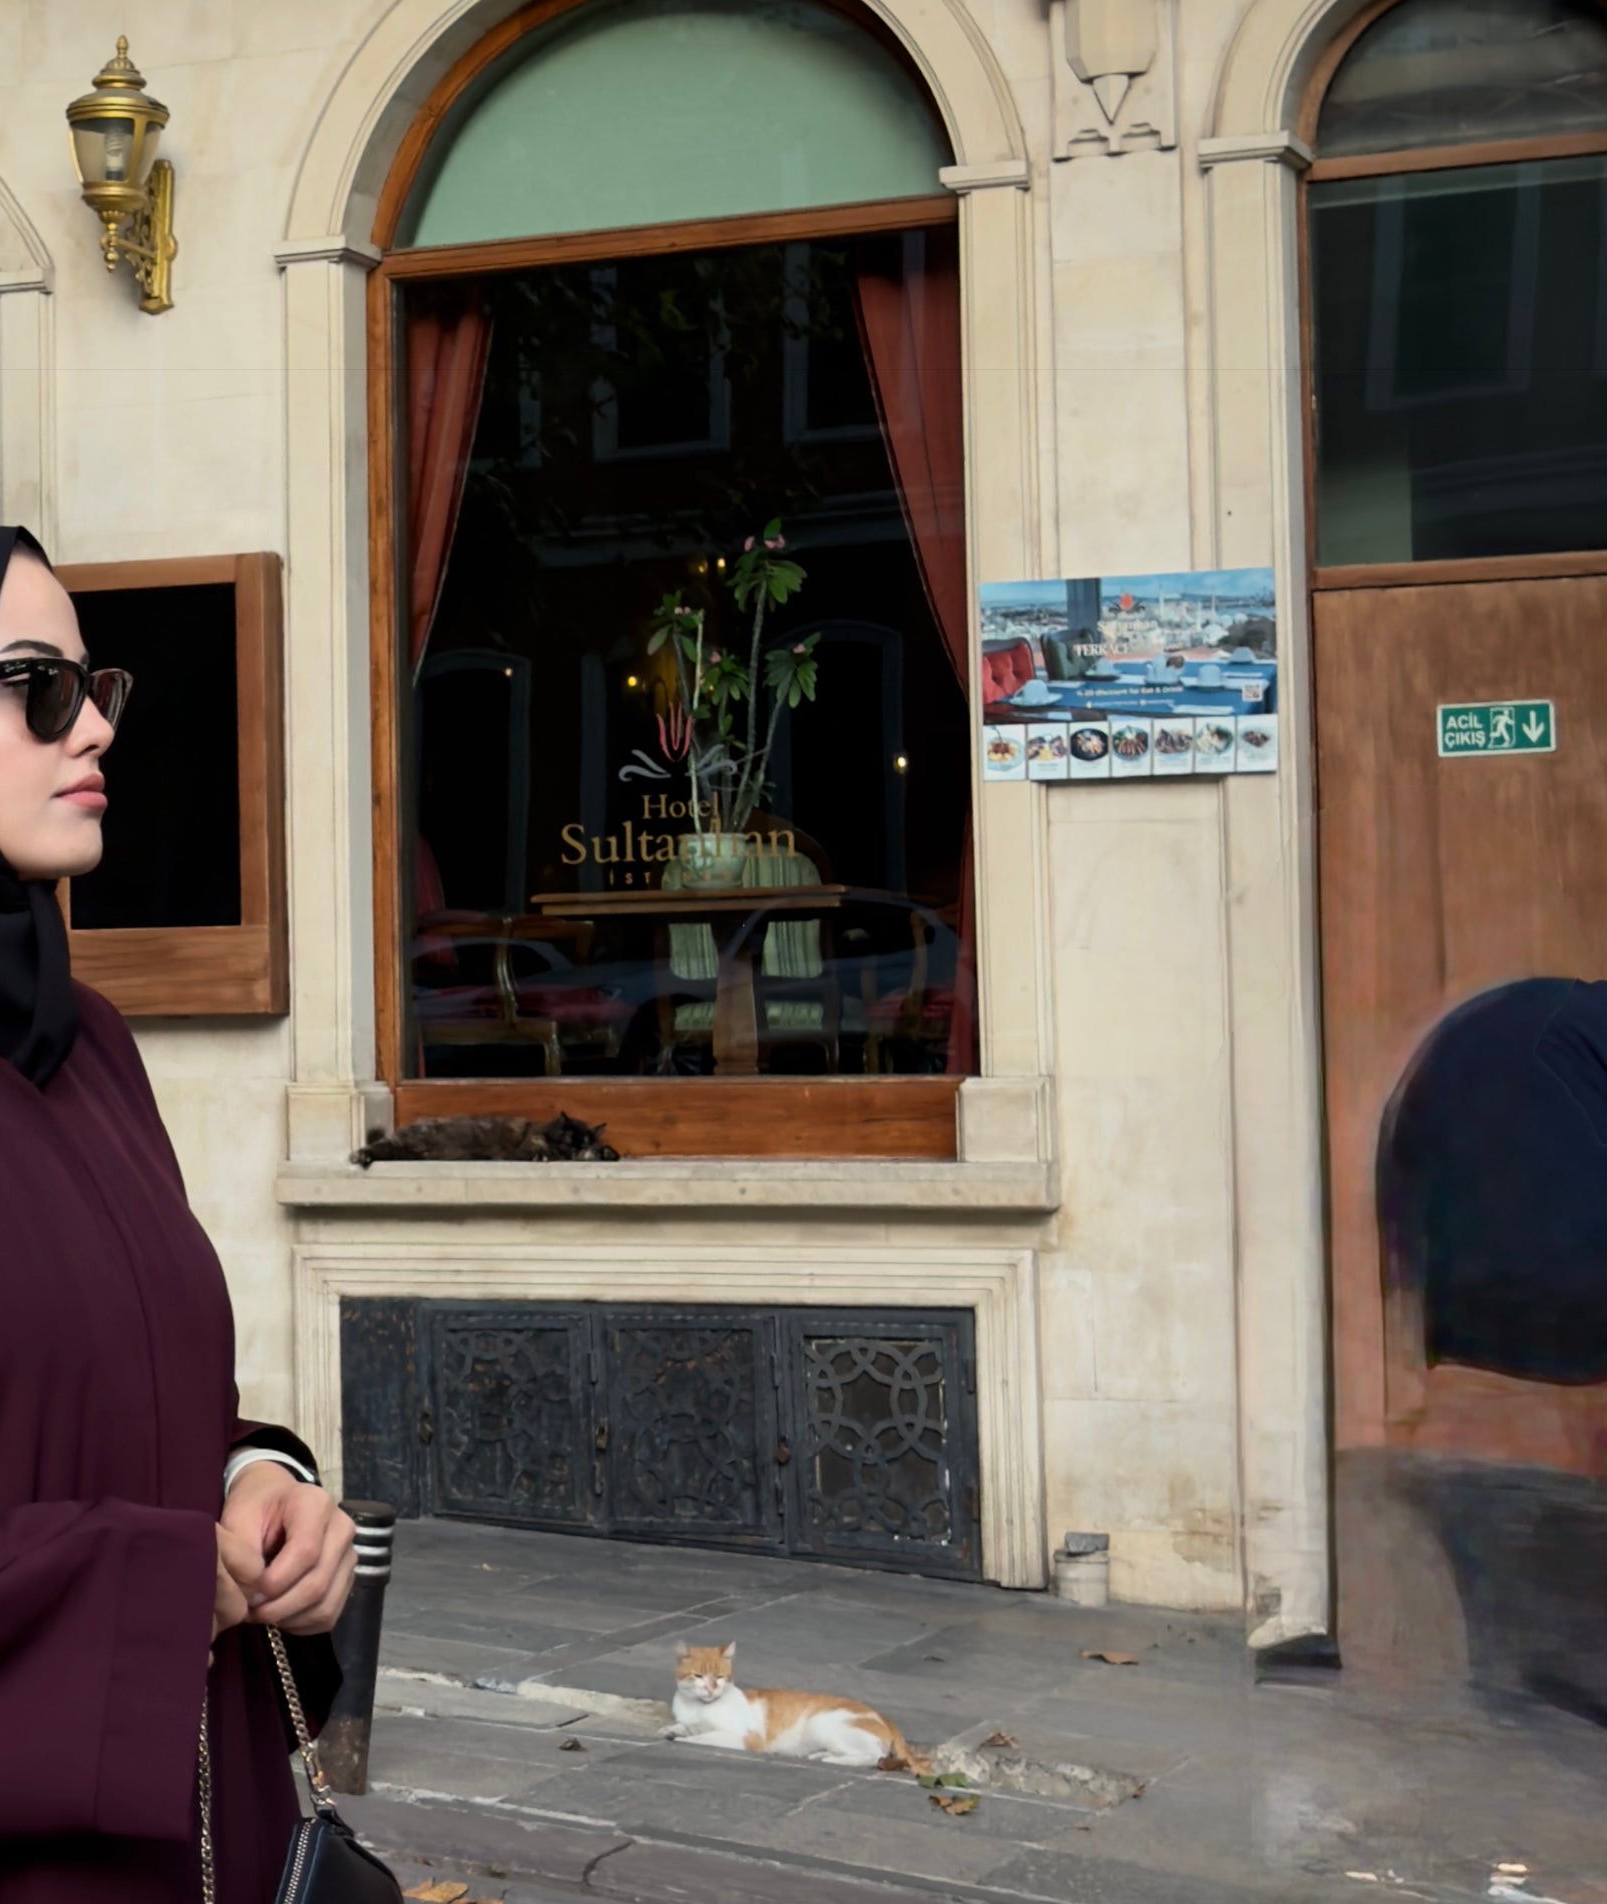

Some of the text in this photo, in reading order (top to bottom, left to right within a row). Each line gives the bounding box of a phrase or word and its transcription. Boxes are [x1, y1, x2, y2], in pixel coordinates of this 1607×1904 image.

[1445, 711, 1483, 730] ACİL
[1444, 730, 1486, 749] ÇIKIŞ
[641, 790, 720, 819] Hotel
[560, 815, 798, 865] Sultanhan
